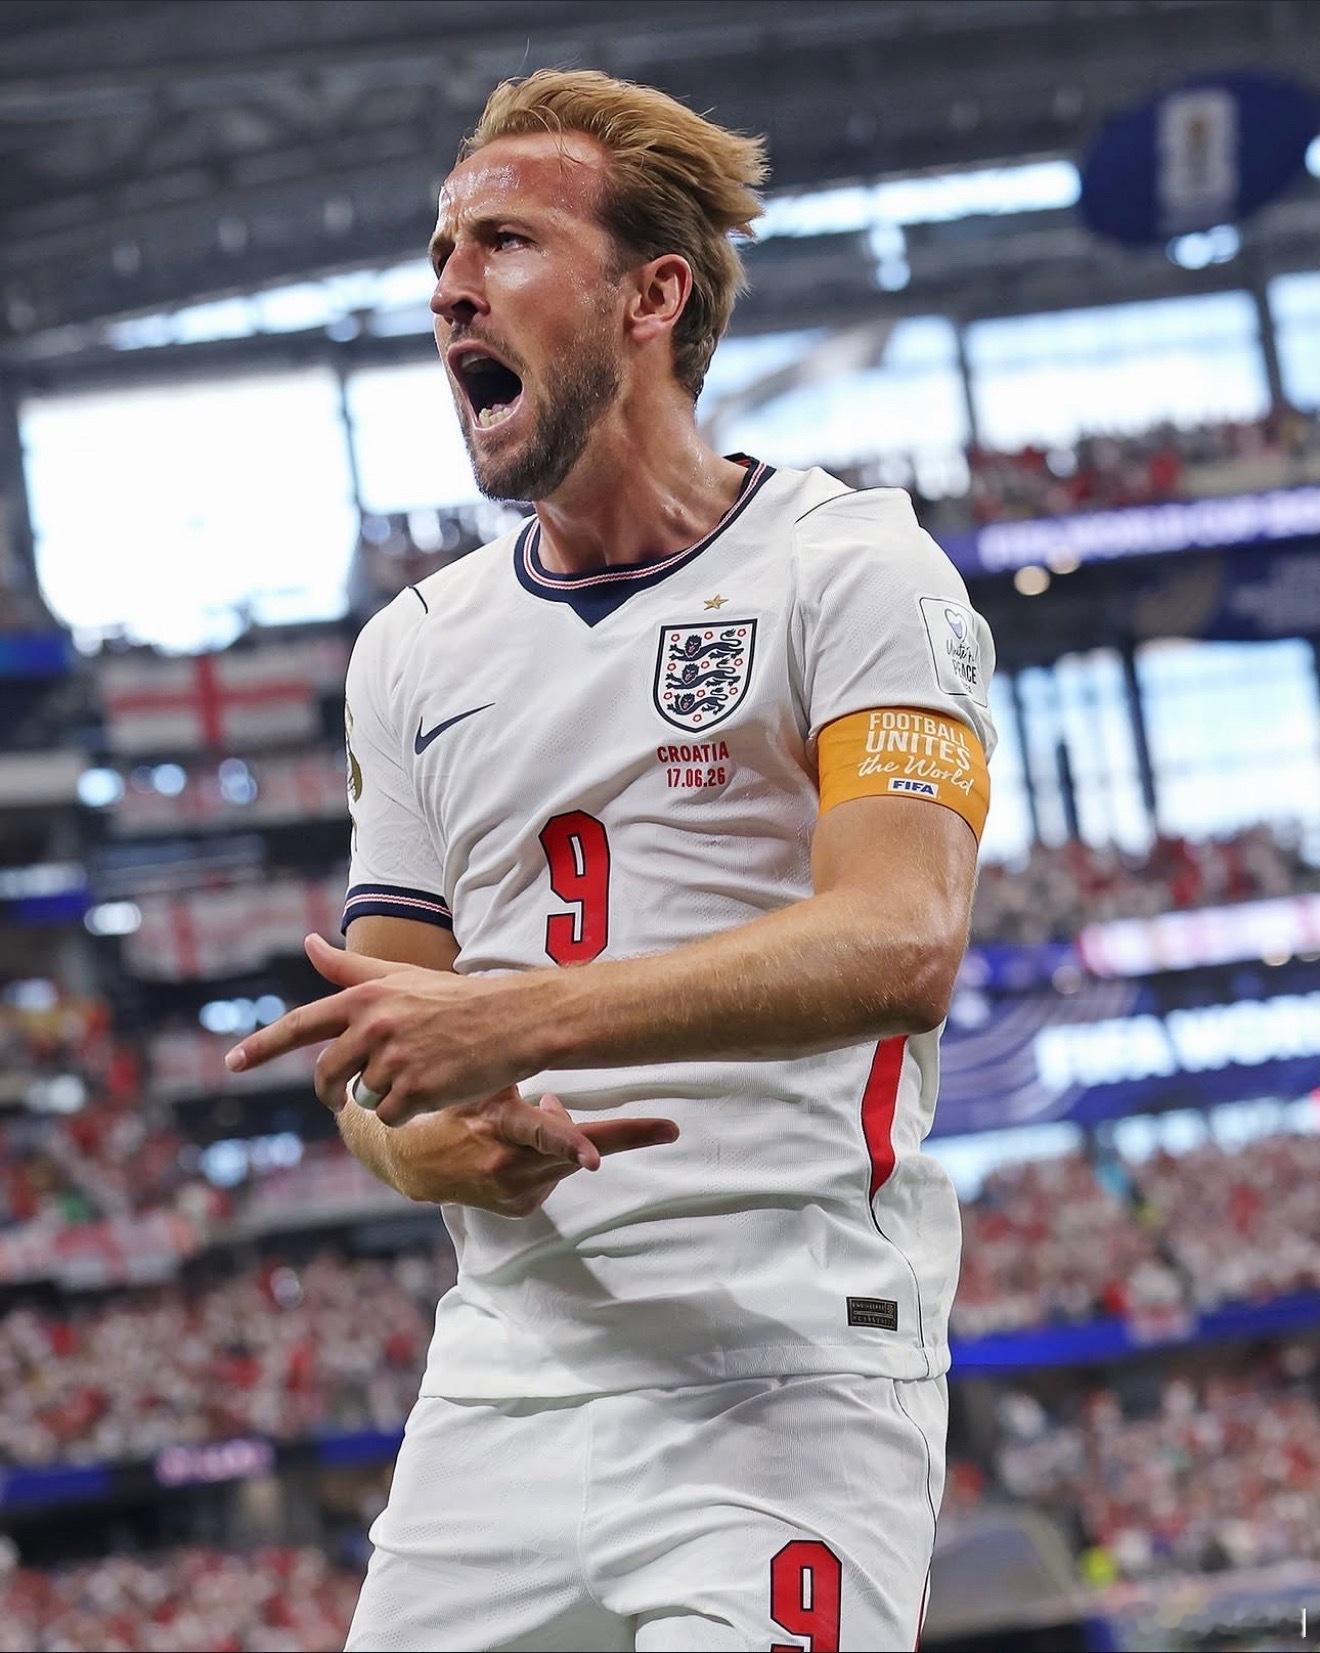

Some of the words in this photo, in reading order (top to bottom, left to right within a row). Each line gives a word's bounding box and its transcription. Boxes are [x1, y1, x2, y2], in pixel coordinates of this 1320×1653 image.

[866, 730, 970, 771] UNITES
[869, 712, 970, 751] FOOTBALL
[657, 741, 730, 763] CROATIA
[666, 767, 726, 787] 17.06.26
[858, 754, 899, 777] the
[904, 755, 974, 796] World
[892, 780, 934, 795] FIFA
[538, 809, 611, 968] 9
[769, 1539, 843, 1652] 9
